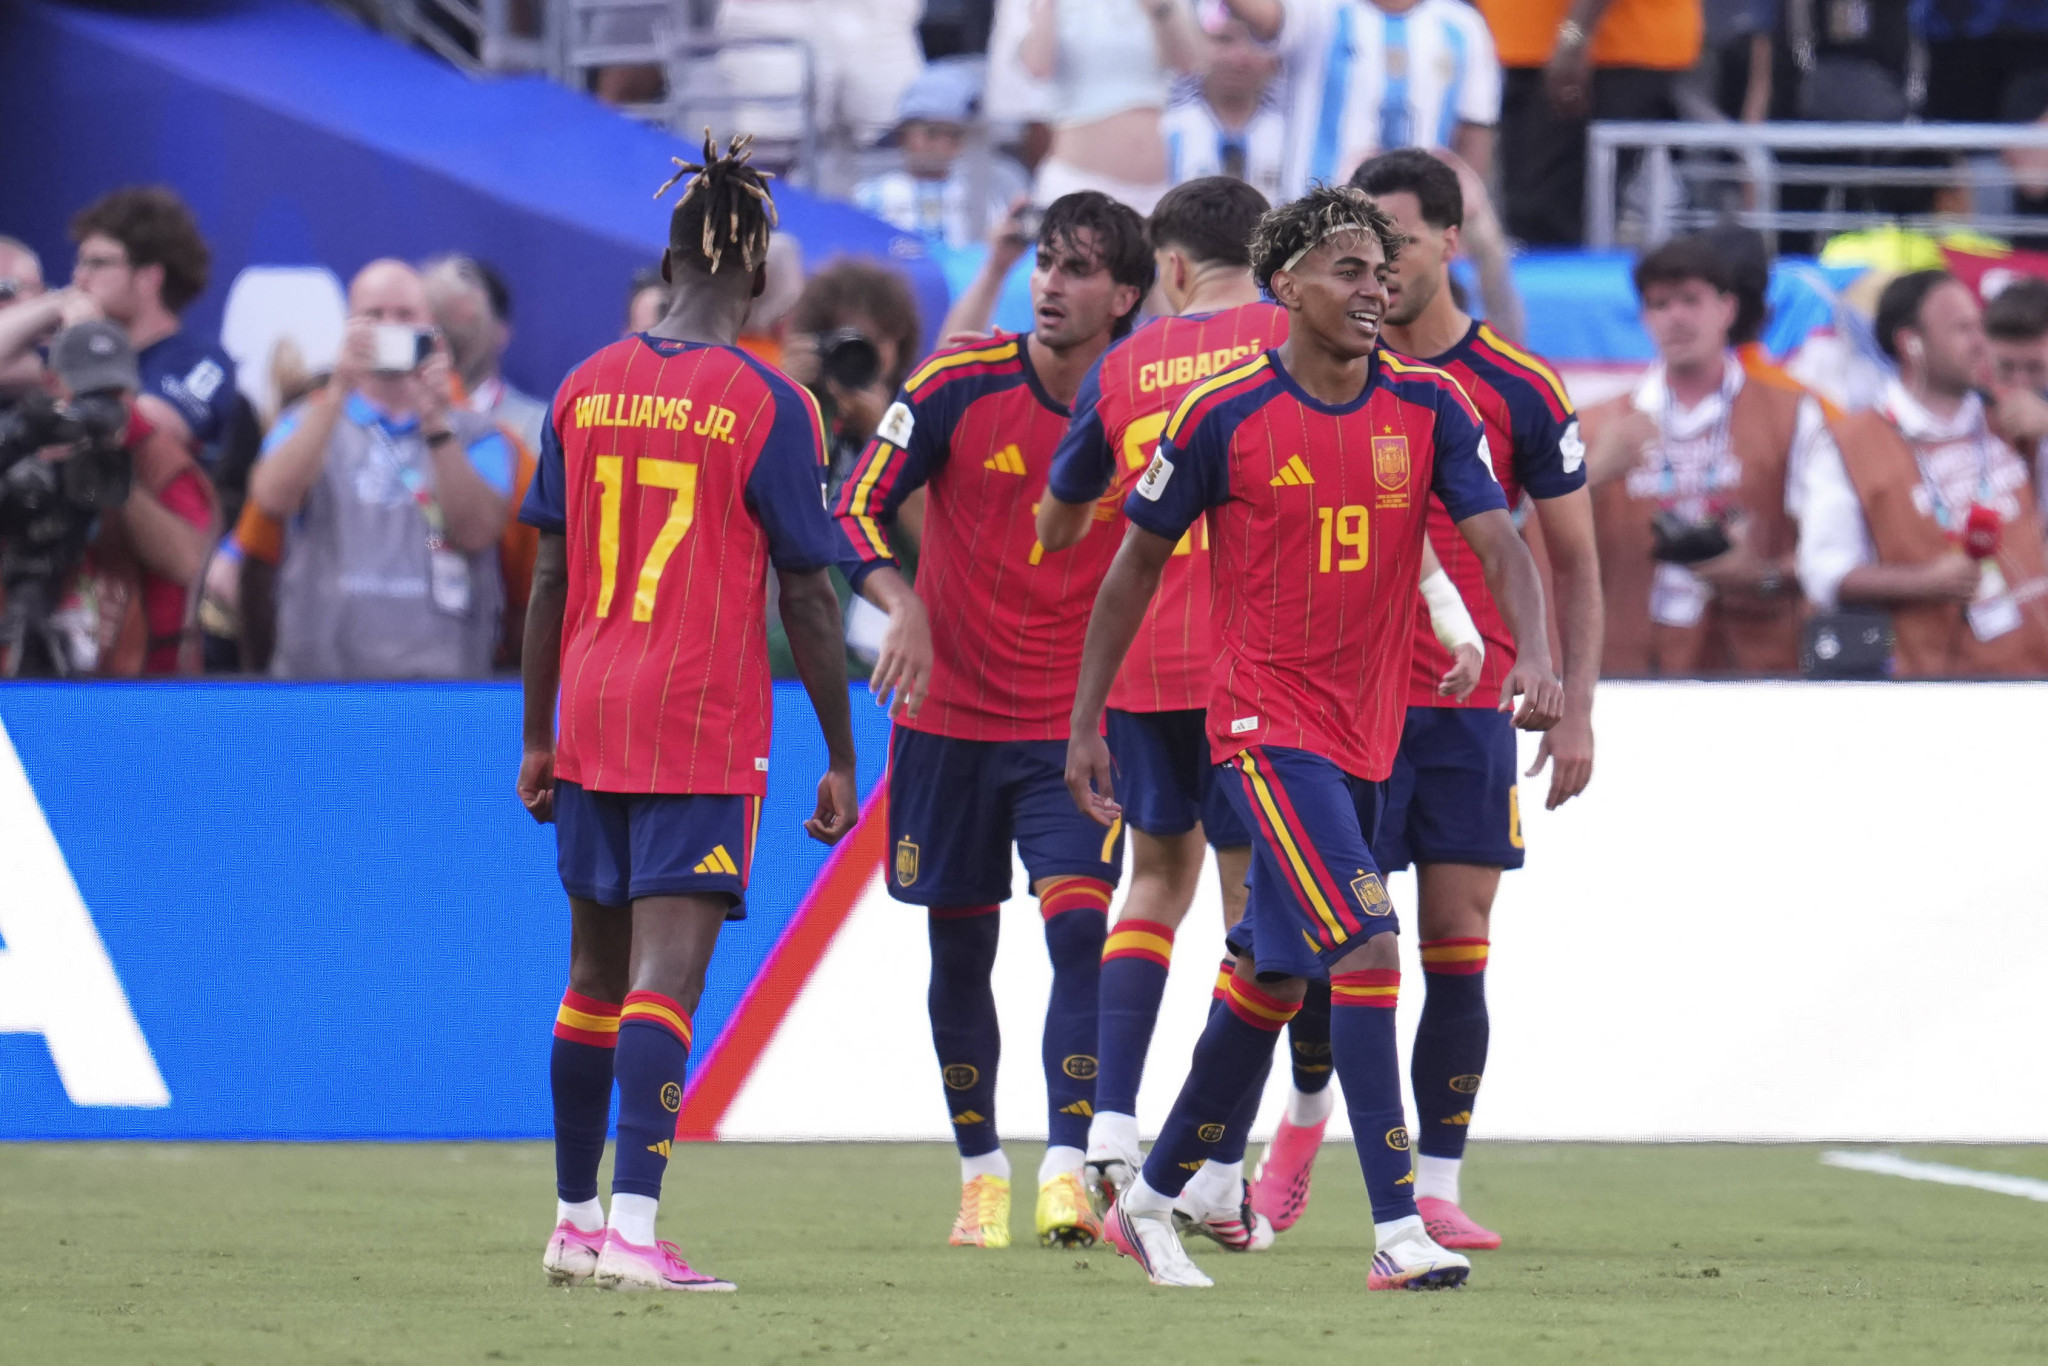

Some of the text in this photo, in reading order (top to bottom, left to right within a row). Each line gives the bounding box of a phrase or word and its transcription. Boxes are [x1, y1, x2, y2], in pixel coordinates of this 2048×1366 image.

[575, 394, 737, 445] WILLIAMS JR.
[595, 455, 698, 623] 17
[1318, 505, 1369, 573] 19
